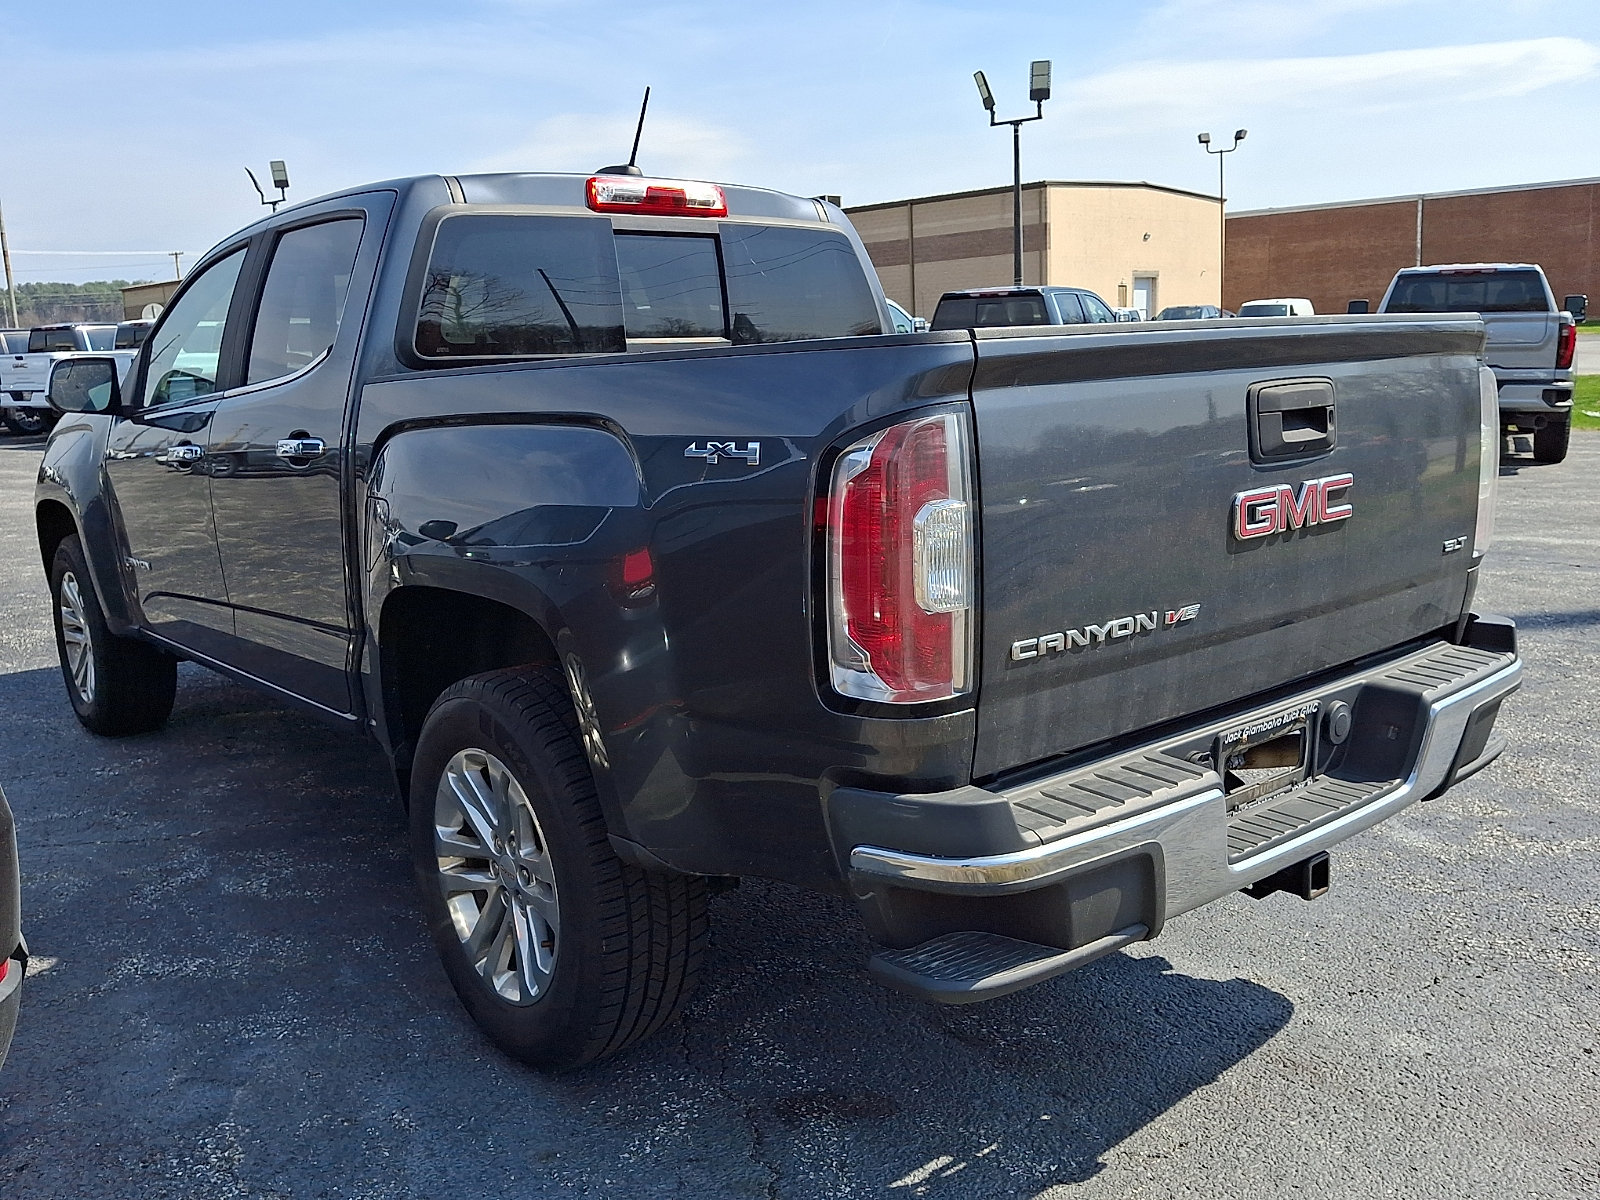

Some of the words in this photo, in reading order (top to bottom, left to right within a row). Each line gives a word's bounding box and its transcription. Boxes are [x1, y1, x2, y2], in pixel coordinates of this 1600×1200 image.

[1234, 473, 1354, 541] GMC
[1443, 535, 1468, 552] SLT
[1011, 611, 1158, 661] CANYON
[1164, 603, 1201, 625] V6
[1224, 730, 1242, 744] Jack
[1300, 703, 1319, 717] GMC
